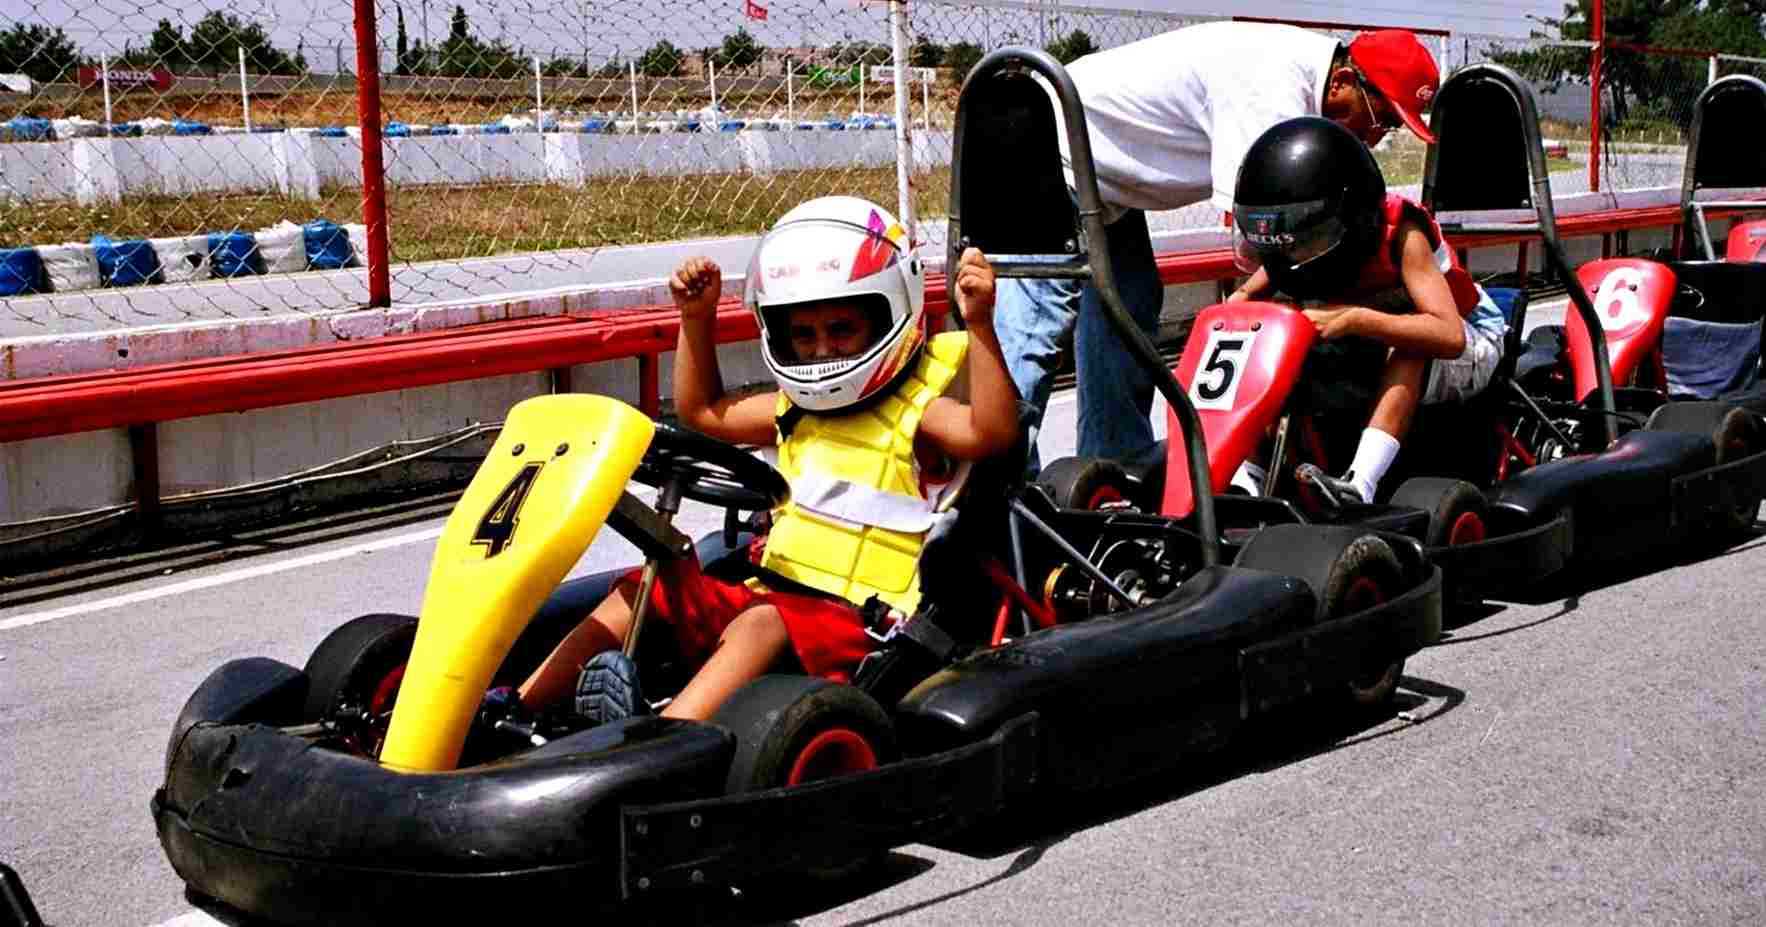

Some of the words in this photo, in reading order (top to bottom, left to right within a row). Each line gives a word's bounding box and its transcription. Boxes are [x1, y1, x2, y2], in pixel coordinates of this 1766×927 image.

[95, 70, 157, 81] HONDA
[1594, 267, 1648, 331] 6
[1198, 340, 1244, 400] 5
[470, 461, 546, 560] 4
